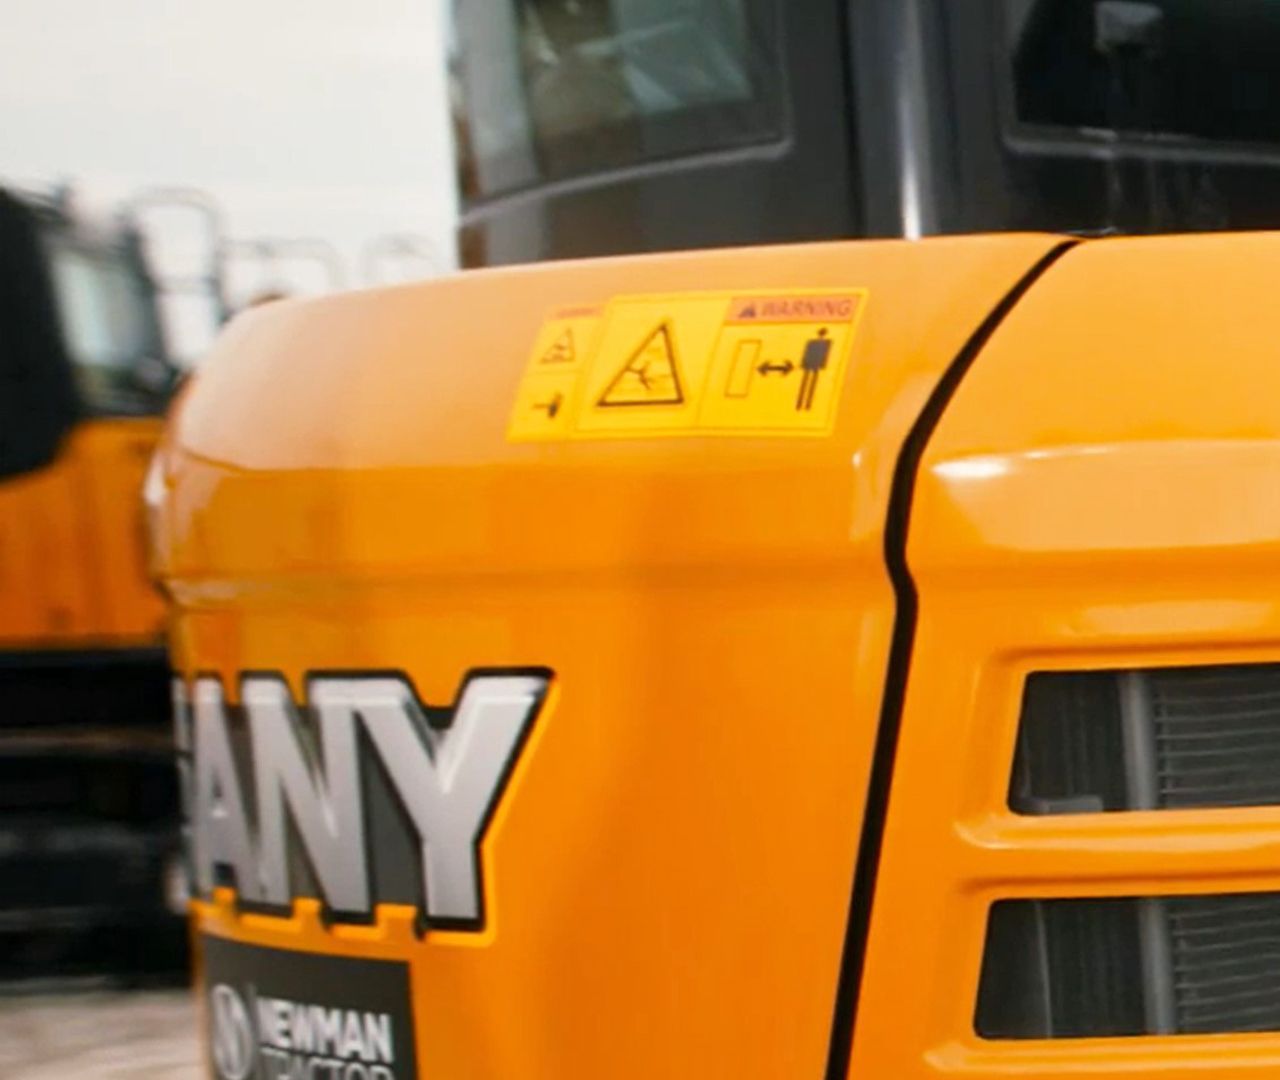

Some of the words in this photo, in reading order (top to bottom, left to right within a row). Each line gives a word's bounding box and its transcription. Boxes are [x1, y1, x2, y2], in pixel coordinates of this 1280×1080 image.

[760, 300, 852, 319] WARNING
[172, 668, 553, 934] ANY
[255, 996, 394, 1064] NEWMAN
